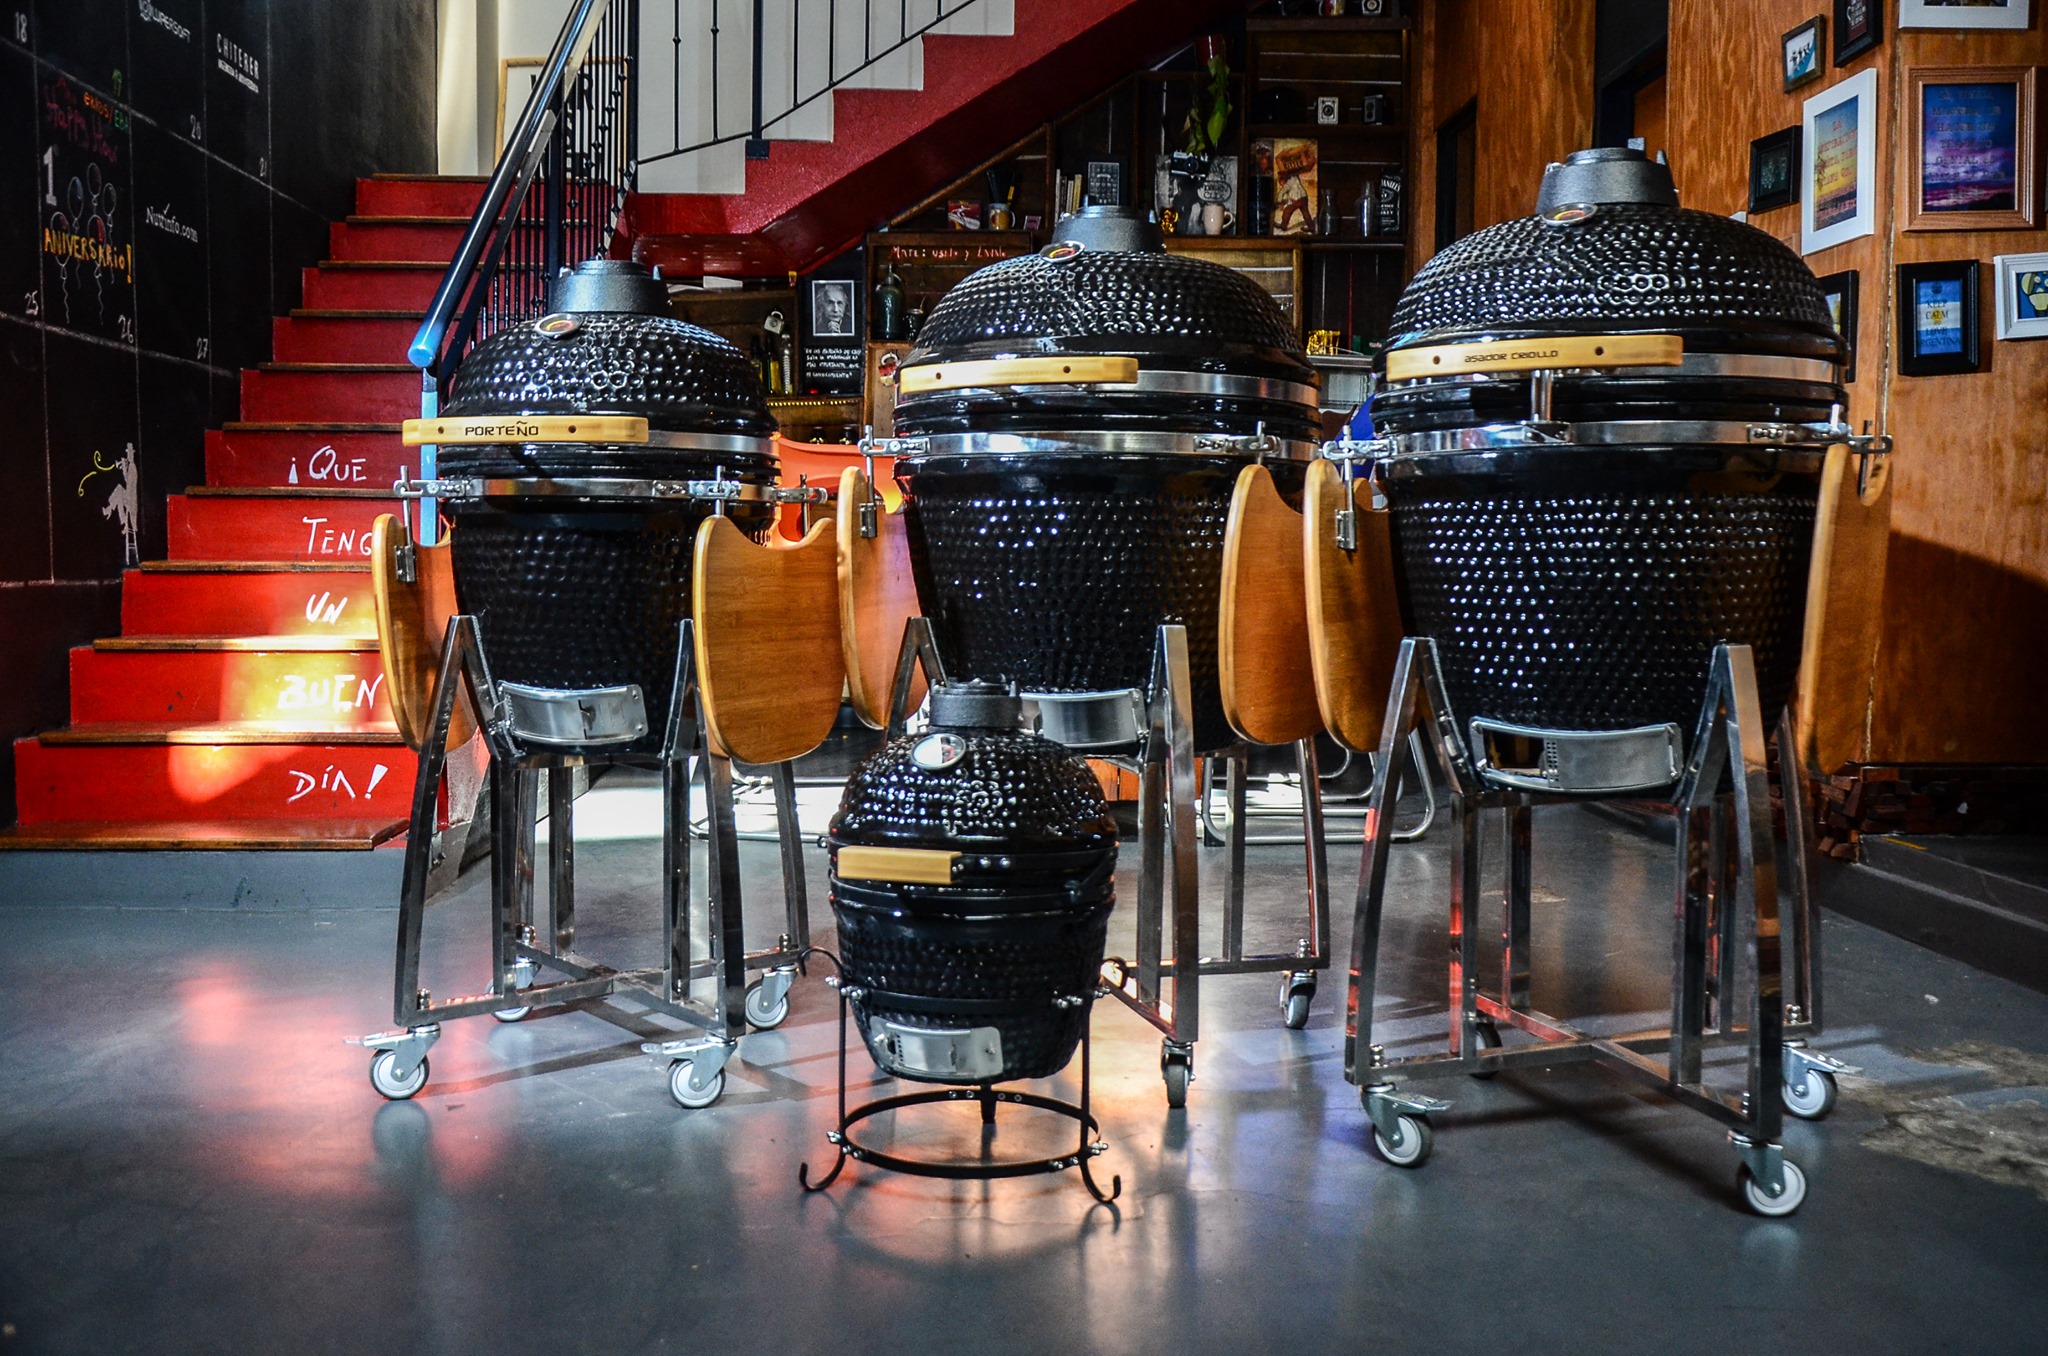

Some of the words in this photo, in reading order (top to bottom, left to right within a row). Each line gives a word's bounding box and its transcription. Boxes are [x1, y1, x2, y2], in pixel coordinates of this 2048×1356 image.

[15, 11, 28, 44] 18
[24, 290, 39, 316] 25
[118, 314, 134, 345] 26
[195, 336, 209, 360] 27
[465, 420, 539, 437] PORTEÑO
[302, 516, 373, 556] TENG
[305, 591, 348, 626] UN
[277, 672, 384, 713] BUEN
